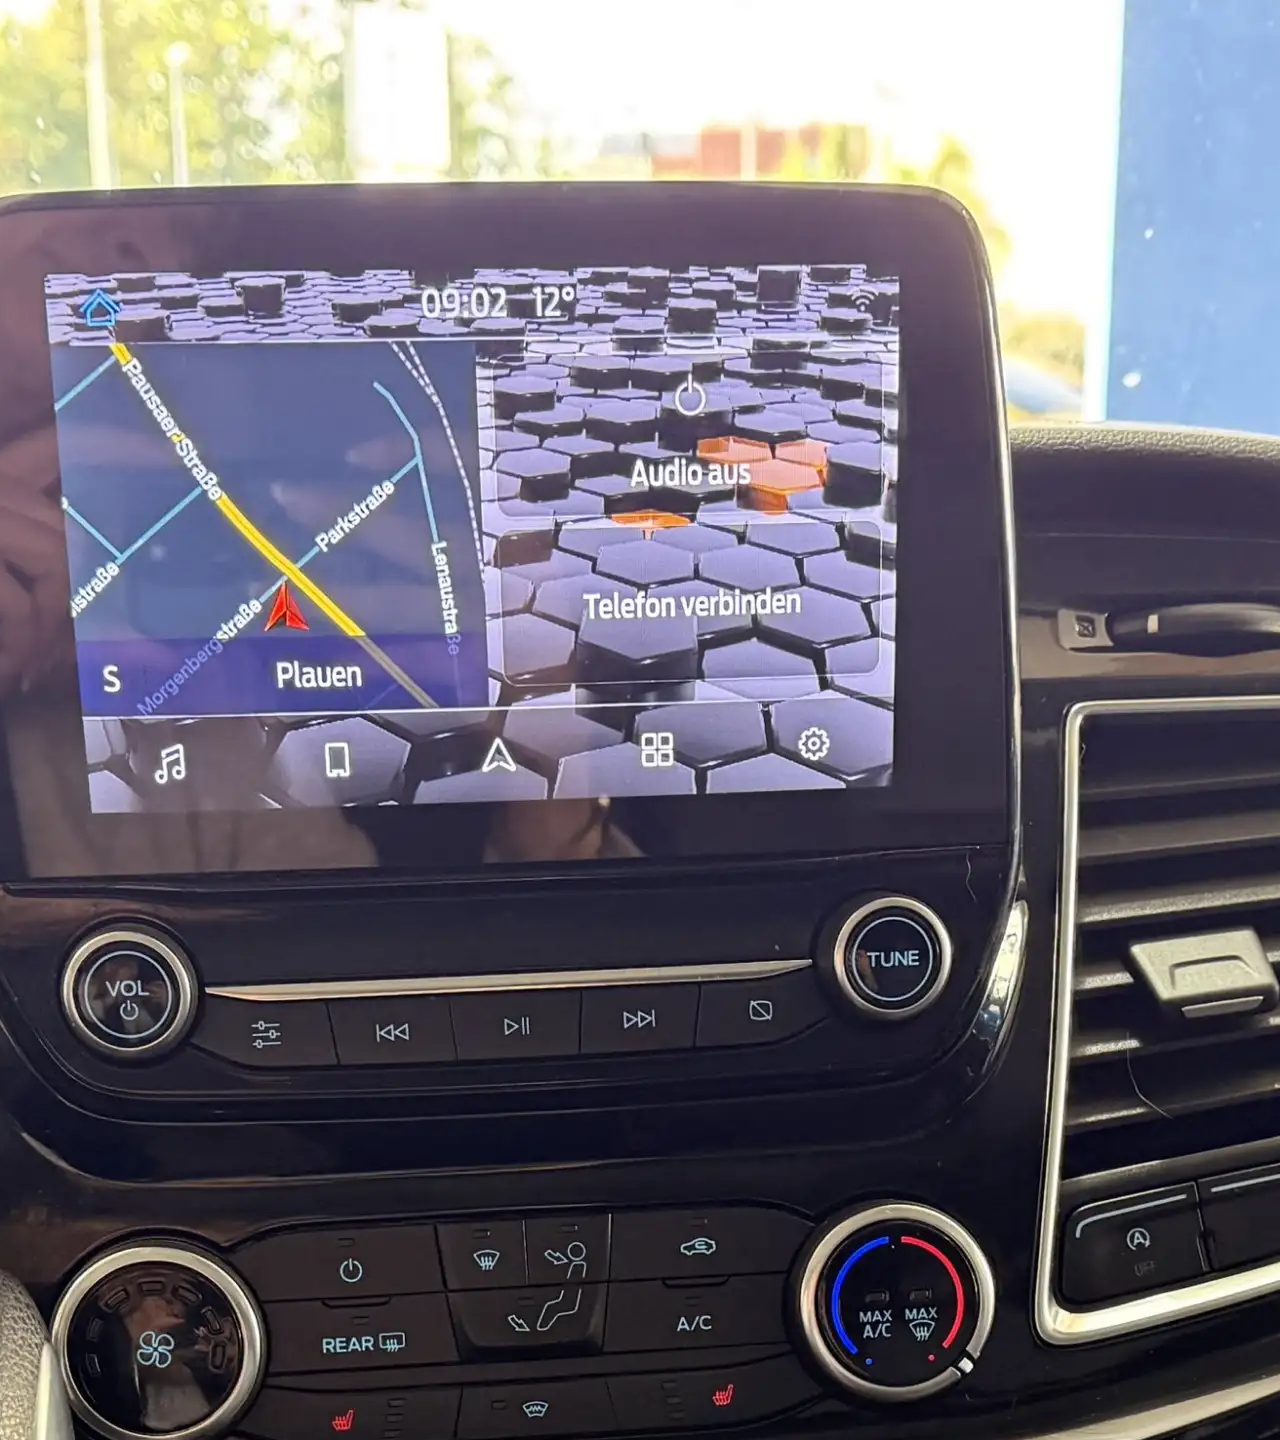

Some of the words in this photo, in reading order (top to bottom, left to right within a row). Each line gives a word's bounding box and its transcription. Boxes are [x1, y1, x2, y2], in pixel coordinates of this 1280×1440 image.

[421, 286, 508, 319] 09:02
[531, 285, 576, 318] 12°
[122, 357, 184, 442] Pausaer
[176, 436, 224, 501] Straße
[631, 457, 703, 488] Audio
[707, 463, 751, 486] aus
[314, 479, 395, 552] Parkstraße
[431, 541, 461, 656] Lenaustraße
[583, 591, 676, 620] Telefon
[681, 586, 802, 617] verbinden
[136, 598, 263, 717] Morgenbergstraße
[102, 664, 121, 693] S
[276, 660, 362, 689] Plauen
[866, 949, 920, 968] TUNE
[105, 979, 150, 998] VOL
[677, 1314, 713, 1333] A/C
[859, 1309, 893, 1323] MAX
[903, 1306, 939, 1321] MAX
[322, 1336, 375, 1354] REAR
[862, 1323, 893, 1339] A/C
